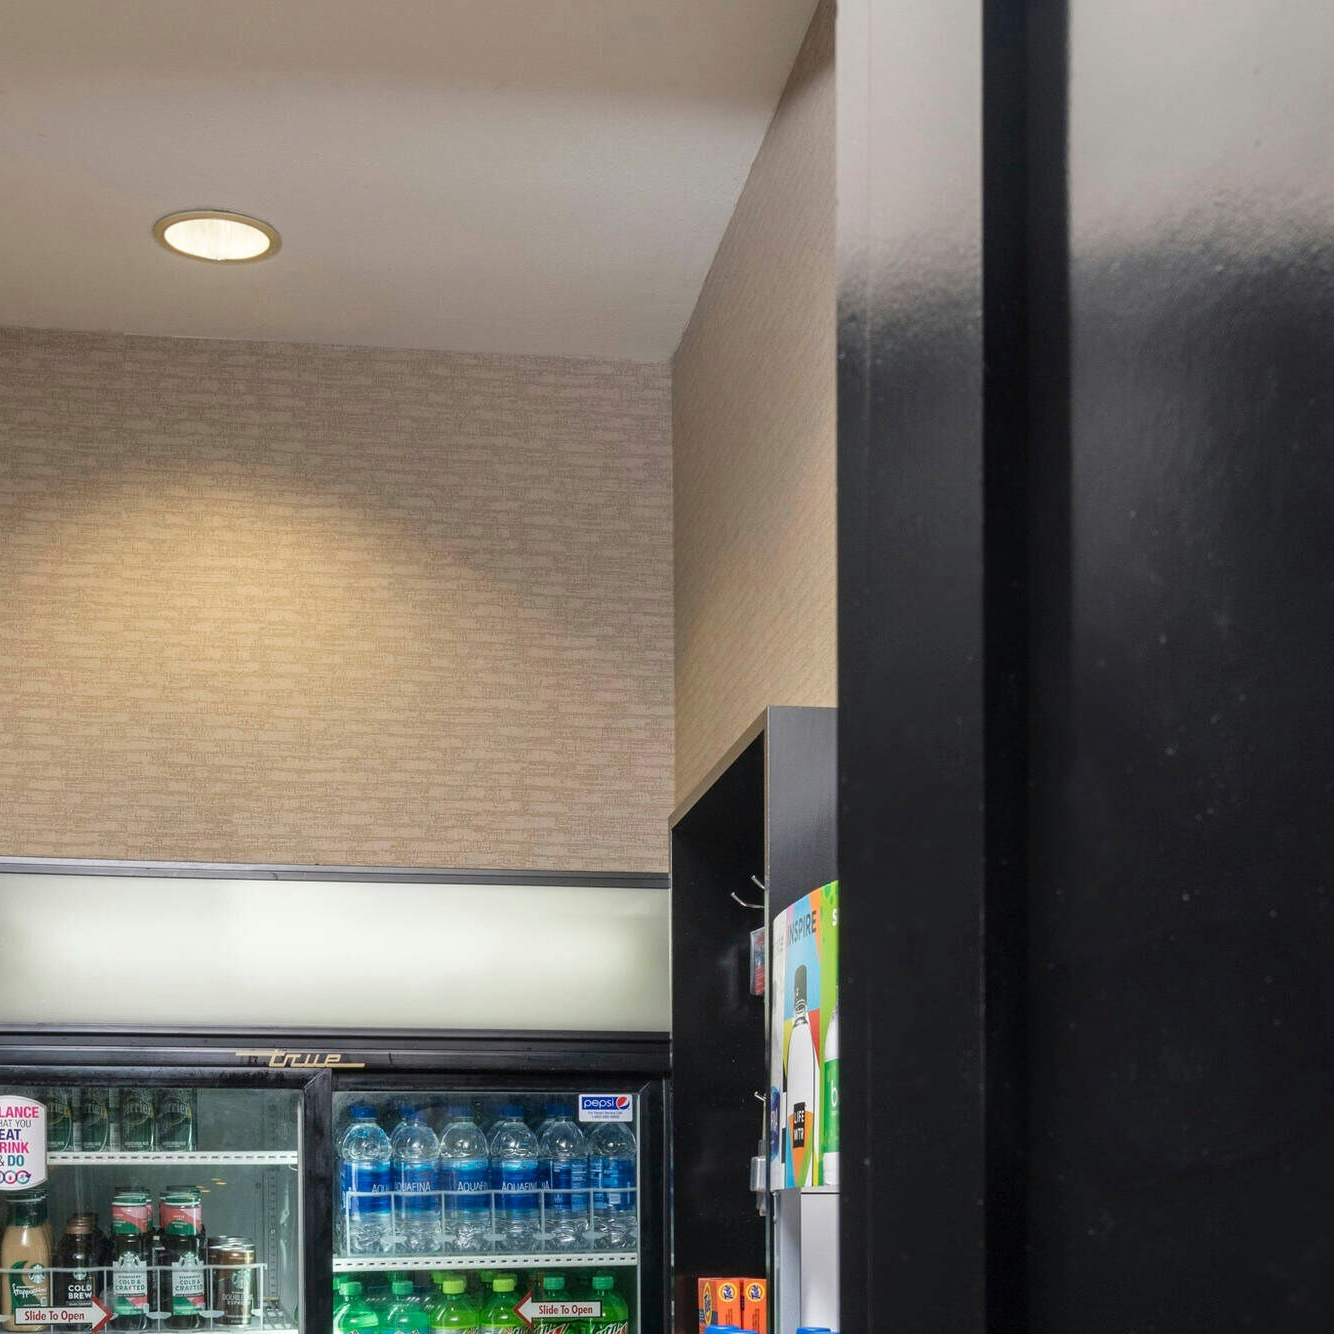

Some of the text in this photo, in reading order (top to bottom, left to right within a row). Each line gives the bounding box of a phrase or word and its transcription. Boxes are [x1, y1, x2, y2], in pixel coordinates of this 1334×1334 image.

[583, 1097, 615, 1109] pepsi
[16, 1119, 32, 1128] YOU
[7, 1154, 25, 1167] DO
[68, 1284, 92, 1292] COLD
[68, 1292, 93, 1300] BREW
[24, 1310, 85, 1322] Slide To Open
[538, 1304, 593, 1316] Slide To Open
